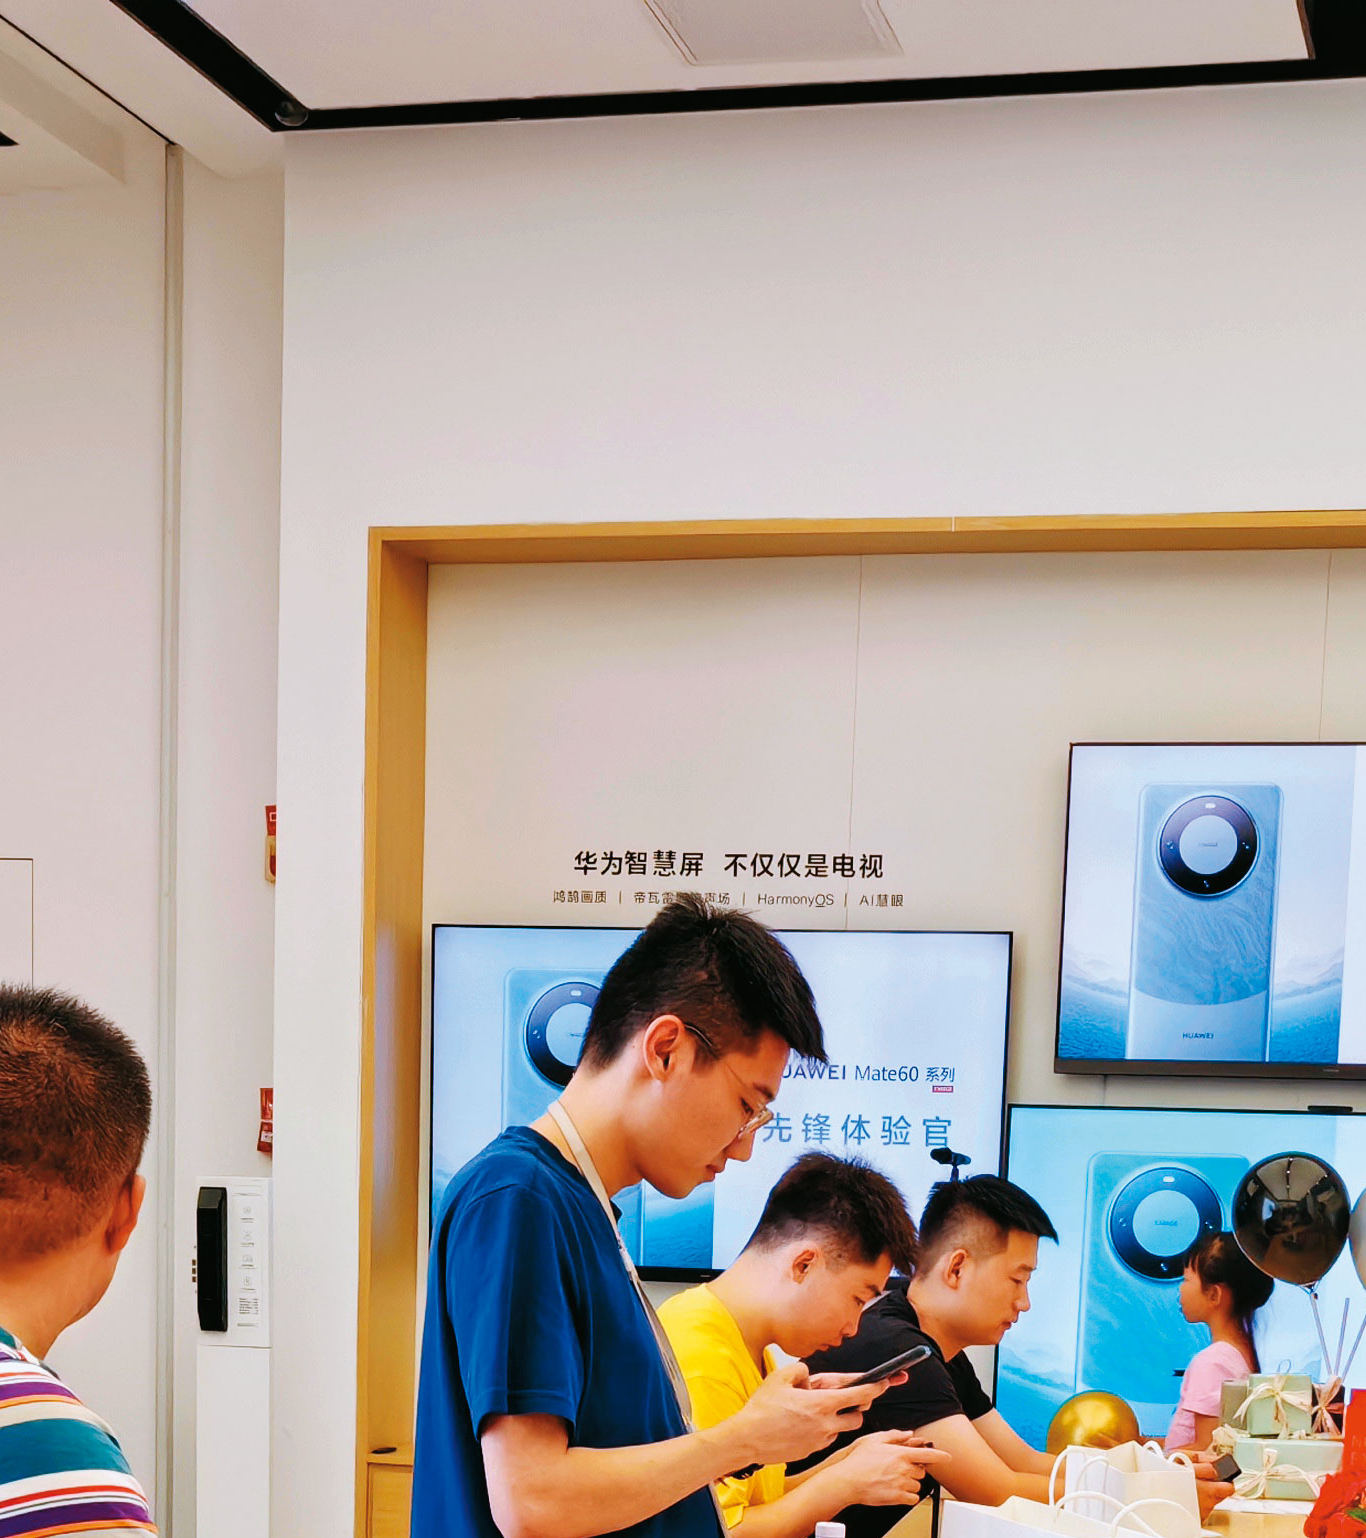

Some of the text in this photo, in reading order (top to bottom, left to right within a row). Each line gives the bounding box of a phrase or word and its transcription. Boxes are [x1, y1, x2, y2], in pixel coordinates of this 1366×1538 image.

[573, 850, 884, 879] 华为智慧屏 不仅仅是电视
[633, 891, 731, 906] 帝瓦雷声场
[757, 893, 834, 909] HarmonyOS
[781, 1063, 956, 1083] UAWEI Mate60 系列
[762, 1111, 953, 1149] 先锋体验官
